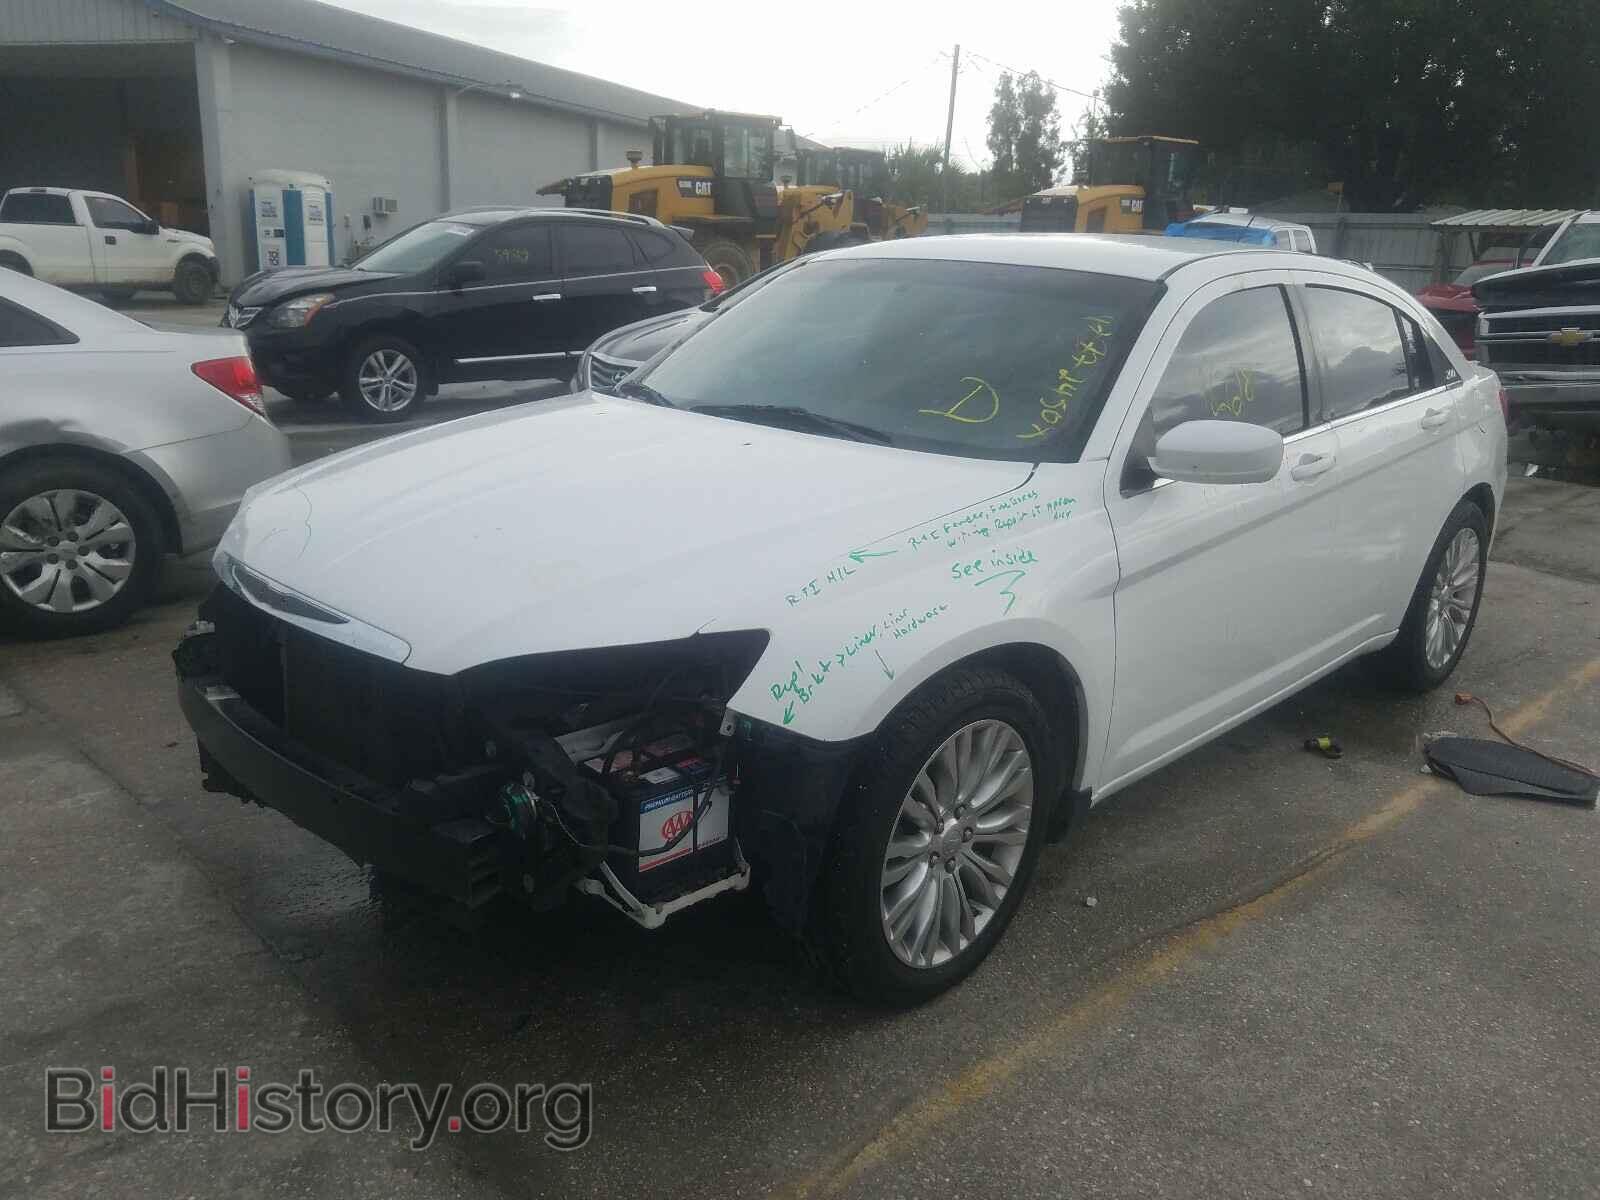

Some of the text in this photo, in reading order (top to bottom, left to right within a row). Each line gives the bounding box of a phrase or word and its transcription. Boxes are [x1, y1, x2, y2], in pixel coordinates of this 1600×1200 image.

[696, 181, 712, 195] CAT
[951, 549, 1040, 580] See inside
